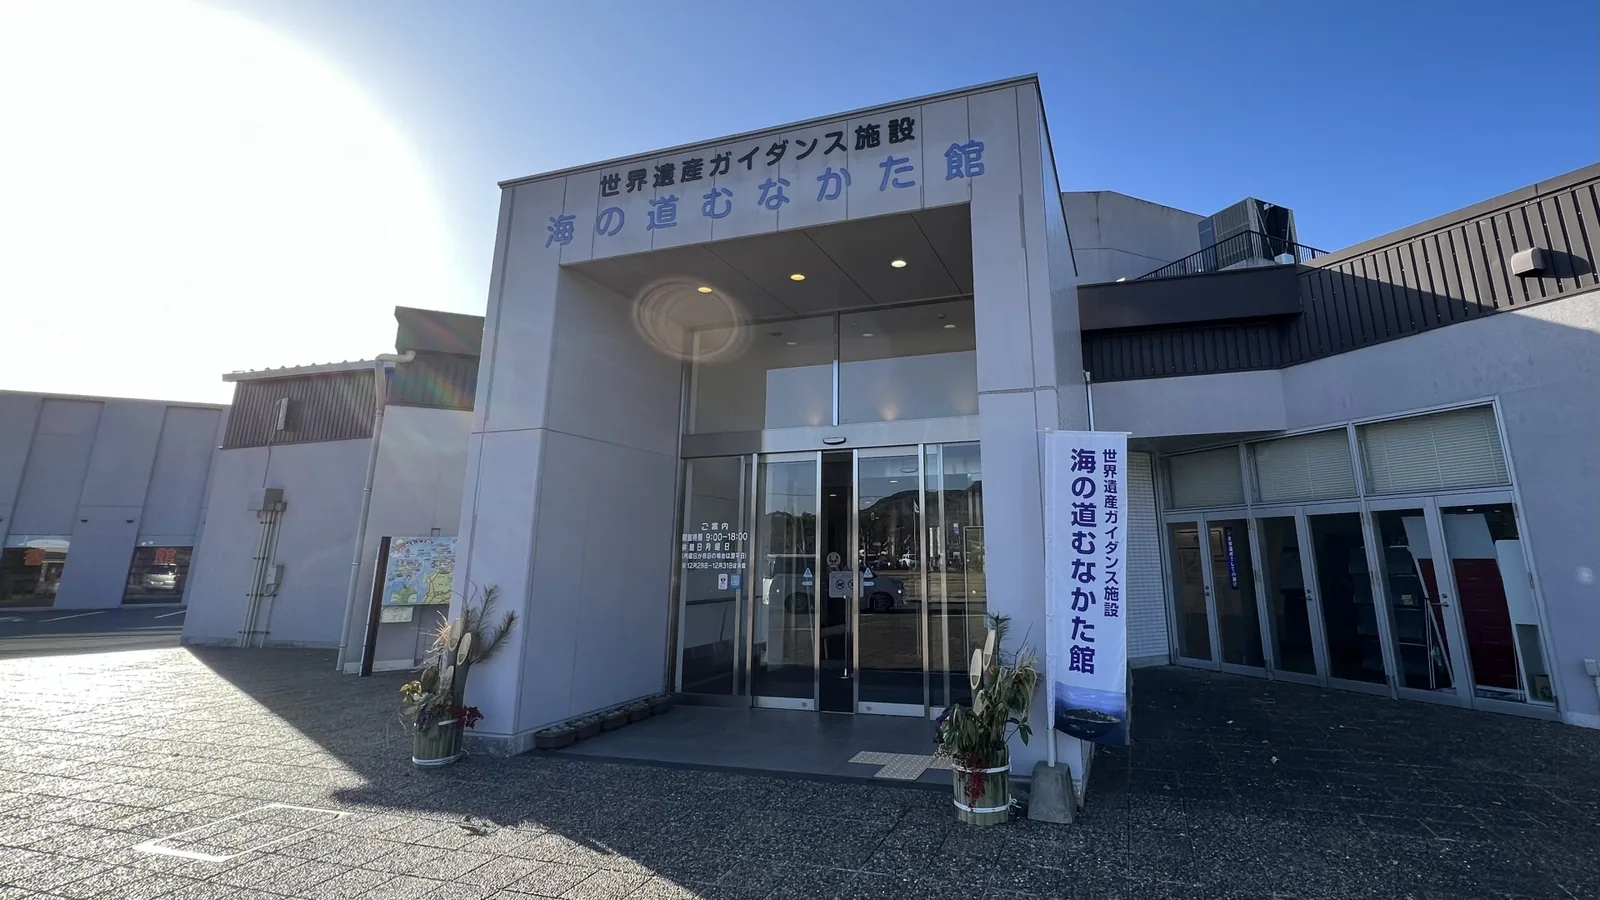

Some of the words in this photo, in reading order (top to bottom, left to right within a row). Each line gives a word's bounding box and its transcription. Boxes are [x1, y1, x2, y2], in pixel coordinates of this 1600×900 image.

[545, 140, 985, 248] 海の道むなかた館
[600, 117, 915, 197] 世界遺産ガイダンス施設
[701, 522, 729, 531] ご案内
[1068, 448, 1097, 675] 海の道むなかた館
[1102, 449, 1119, 618] 世界遺産ガイダンス施設
